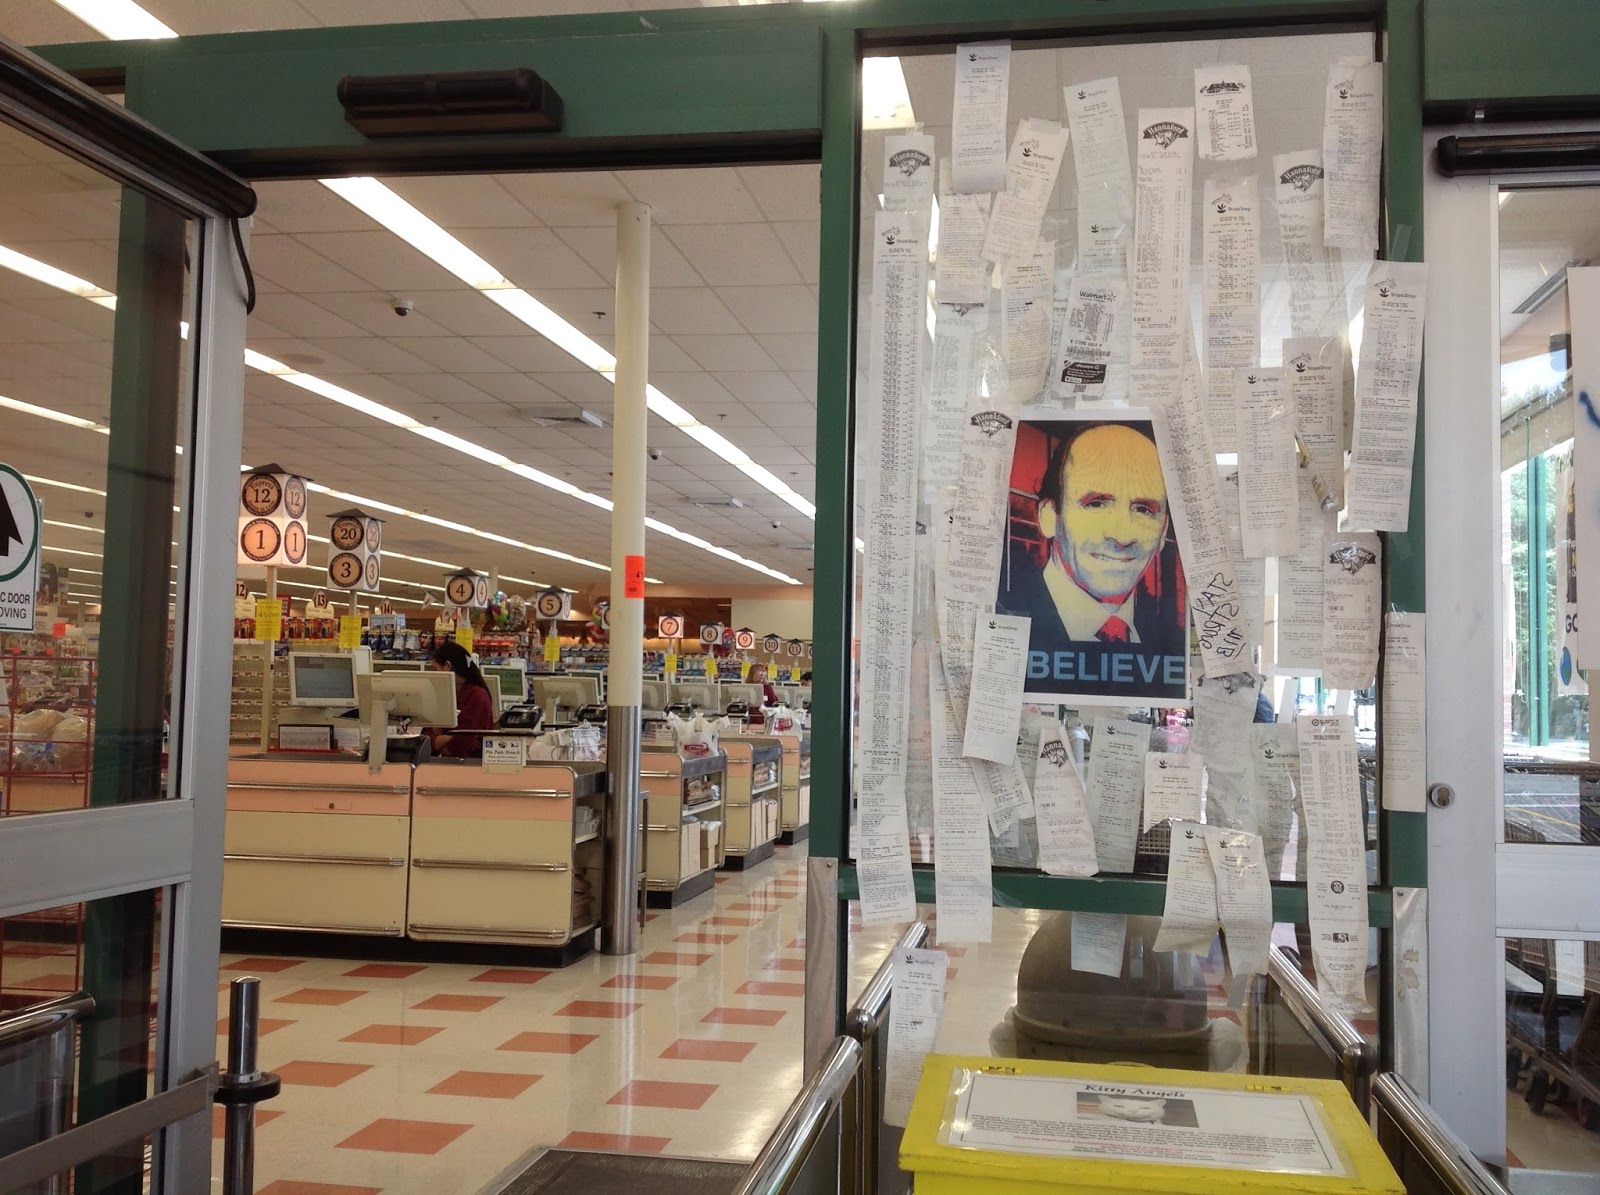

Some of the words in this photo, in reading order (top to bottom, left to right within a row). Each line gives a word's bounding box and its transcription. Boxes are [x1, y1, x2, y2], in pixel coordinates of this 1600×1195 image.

[1147, 123, 1185, 135] Hannaford
[1080, 291, 1107, 300] Walmart
[249, 480, 275, 490] Express
[253, 488, 271, 503] 12
[290, 490, 300, 507] 12
[256, 529, 265, 550] 1
[340, 528, 357, 540] 20
[292, 532, 298, 553] 1
[340, 561, 351, 579] 3
[369, 563, 375, 580] 3
[236, 583, 245, 597] 12
[455, 583, 466, 597] 4
[479, 584, 485, 596] 4
[8, 592, 30, 604] DOOR
[317, 594, 325, 606] 13
[546, 599, 554, 610] 5
[666, 621, 673, 632] 7
[706, 630, 713, 638] 8
[1026, 650, 1186, 685] BELIEVE
[1085, 1084, 1126, 1095] Kitty
[1132, 1087, 1186, 1098] Angels
